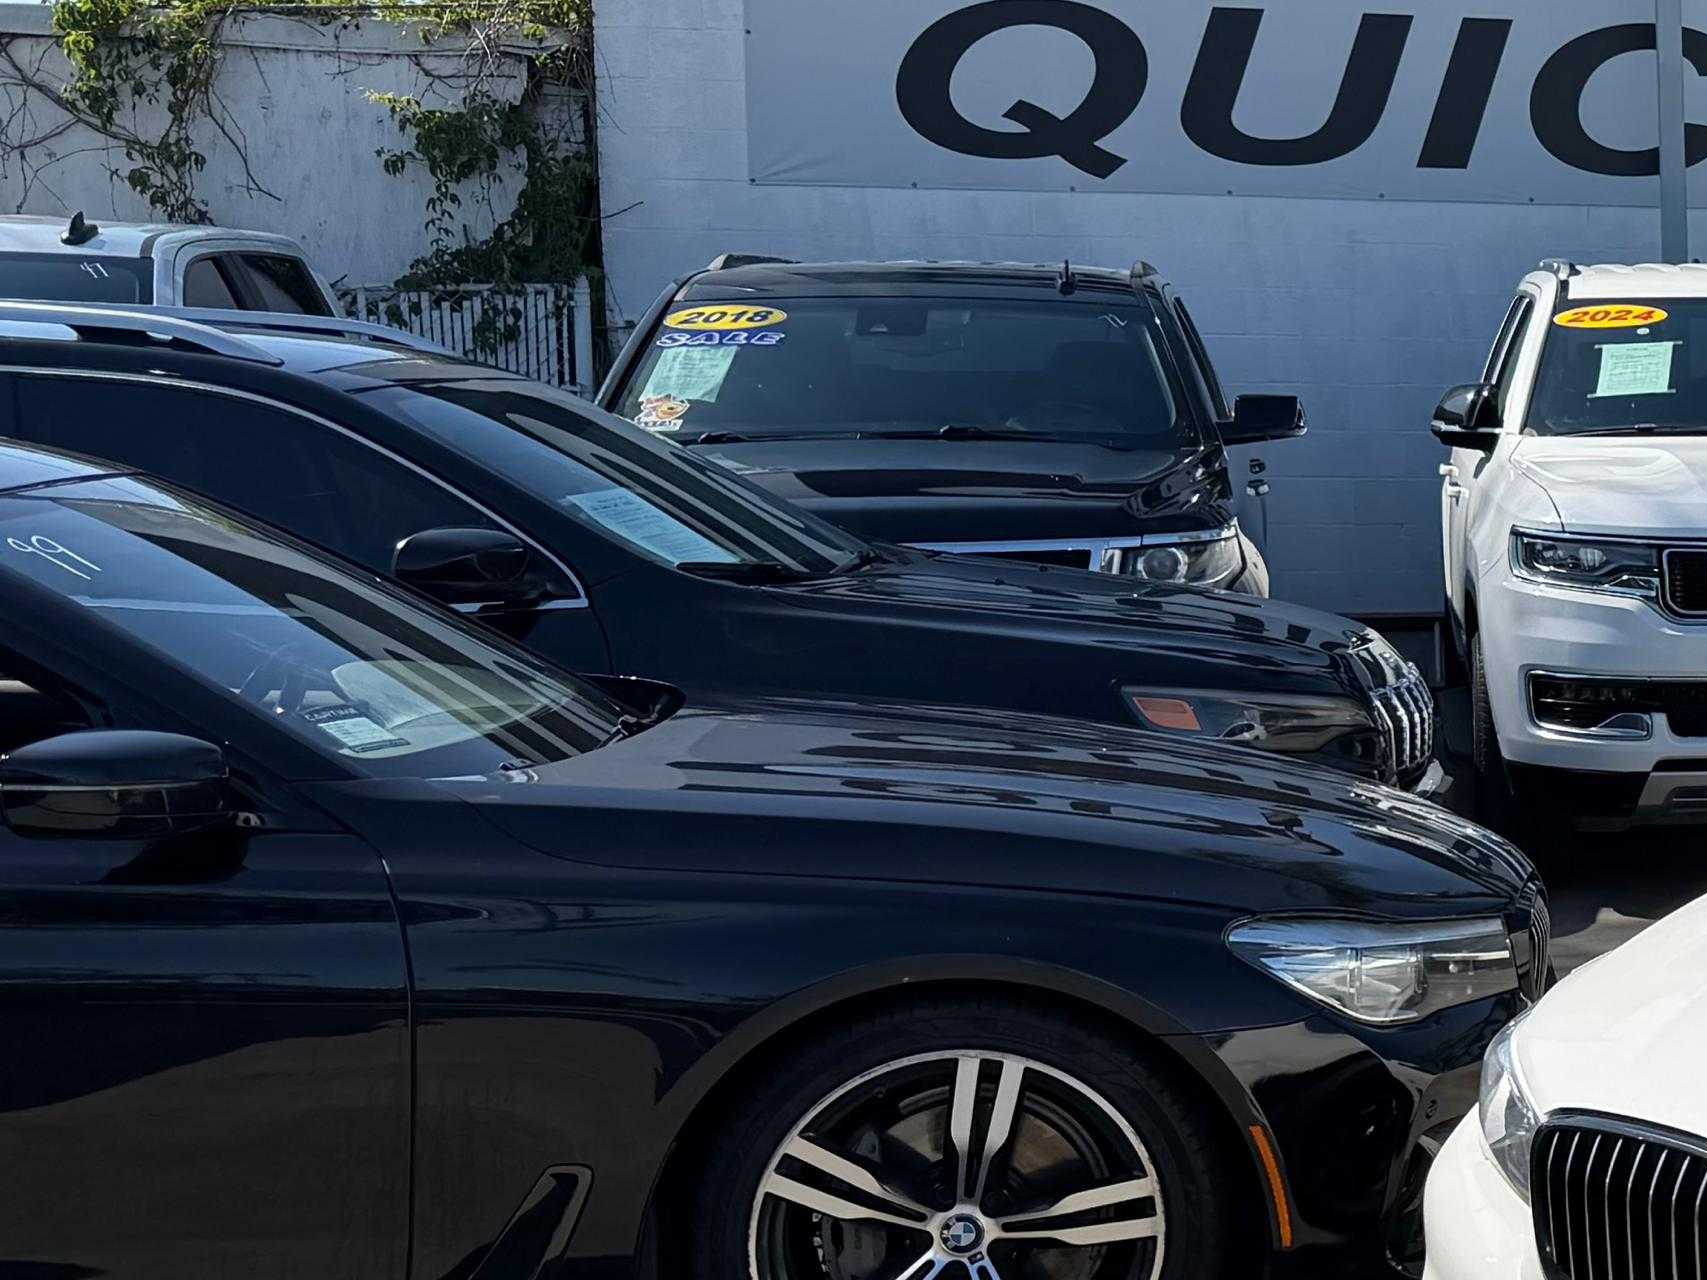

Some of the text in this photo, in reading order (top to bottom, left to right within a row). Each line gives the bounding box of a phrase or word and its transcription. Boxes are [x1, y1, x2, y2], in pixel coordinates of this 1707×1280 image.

[675, 310, 775, 325] 2018
[1566, 309, 1655, 324] 2024
[655, 331, 786, 347] SALE
[7, 535, 102, 581] 99
